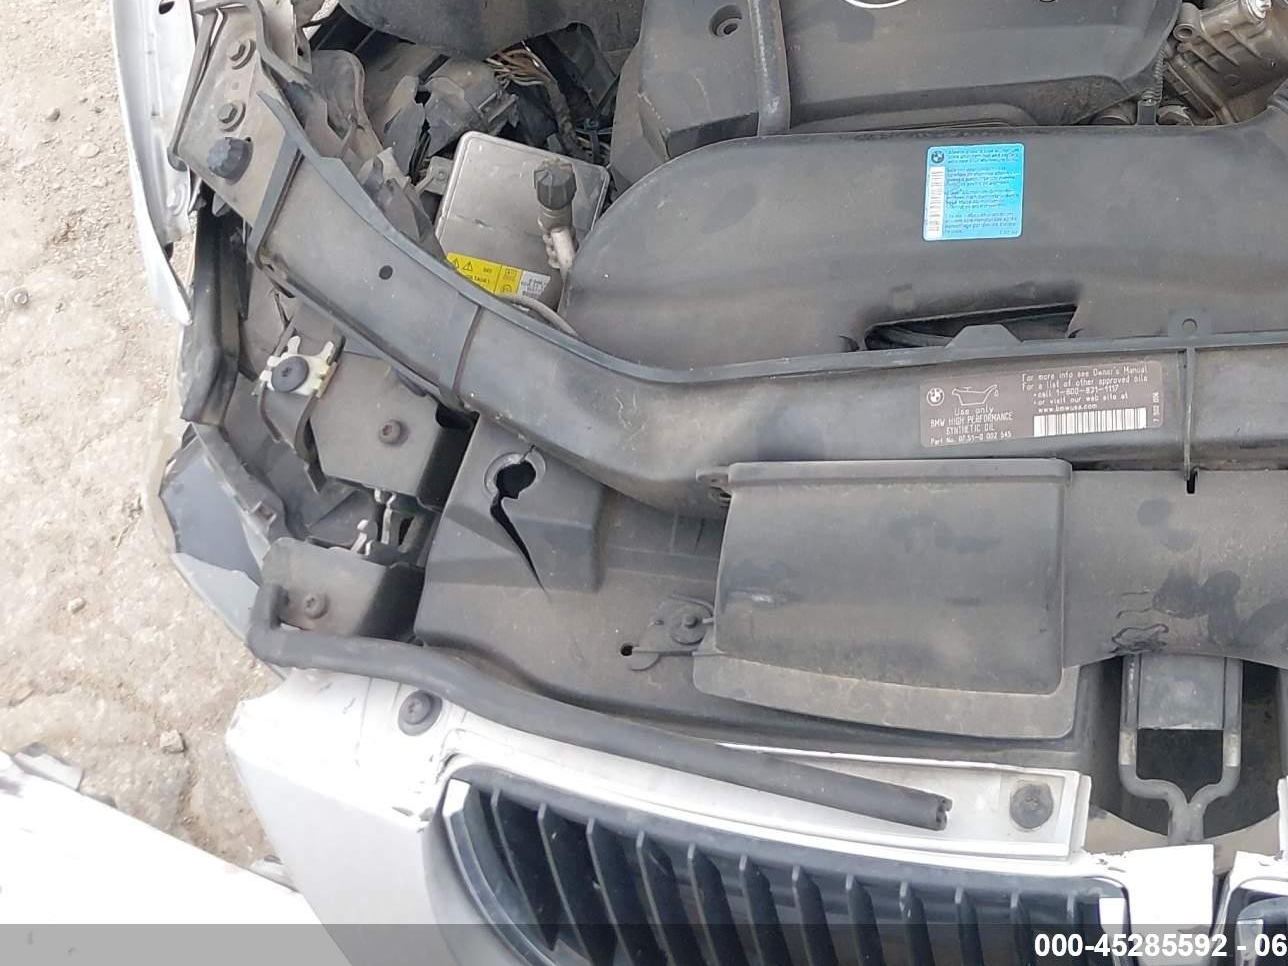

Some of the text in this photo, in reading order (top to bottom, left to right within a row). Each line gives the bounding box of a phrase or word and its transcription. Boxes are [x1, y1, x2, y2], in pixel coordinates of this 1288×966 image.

[1022, 373, 1034, 382] For
[1059, 370, 1073, 379] info
[1123, 365, 1148, 374] Manual
[1022, 382, 1034, 391] For
[1046, 379, 1060, 389] list
[1063, 379, 1071, 388] of
[1075, 377, 1094, 387] other
[1098, 375, 1130, 386] approved
[1133, 374, 1148, 383] oils
[1050, 395, 1066, 404] visit
[1085, 394, 1099, 402] web
[1102, 393, 1117, 402] site
[1120, 392, 1129, 400] at
[954, 404, 994, 416] Use only
[1038, 404, 1098, 413] www.bmwusa.com
[930, 411, 1013, 428] BMW HIGH PERFORMANCE
[946, 423, 995, 435] SYNTHETIC OIL
[930, 437, 943, 445] Part
